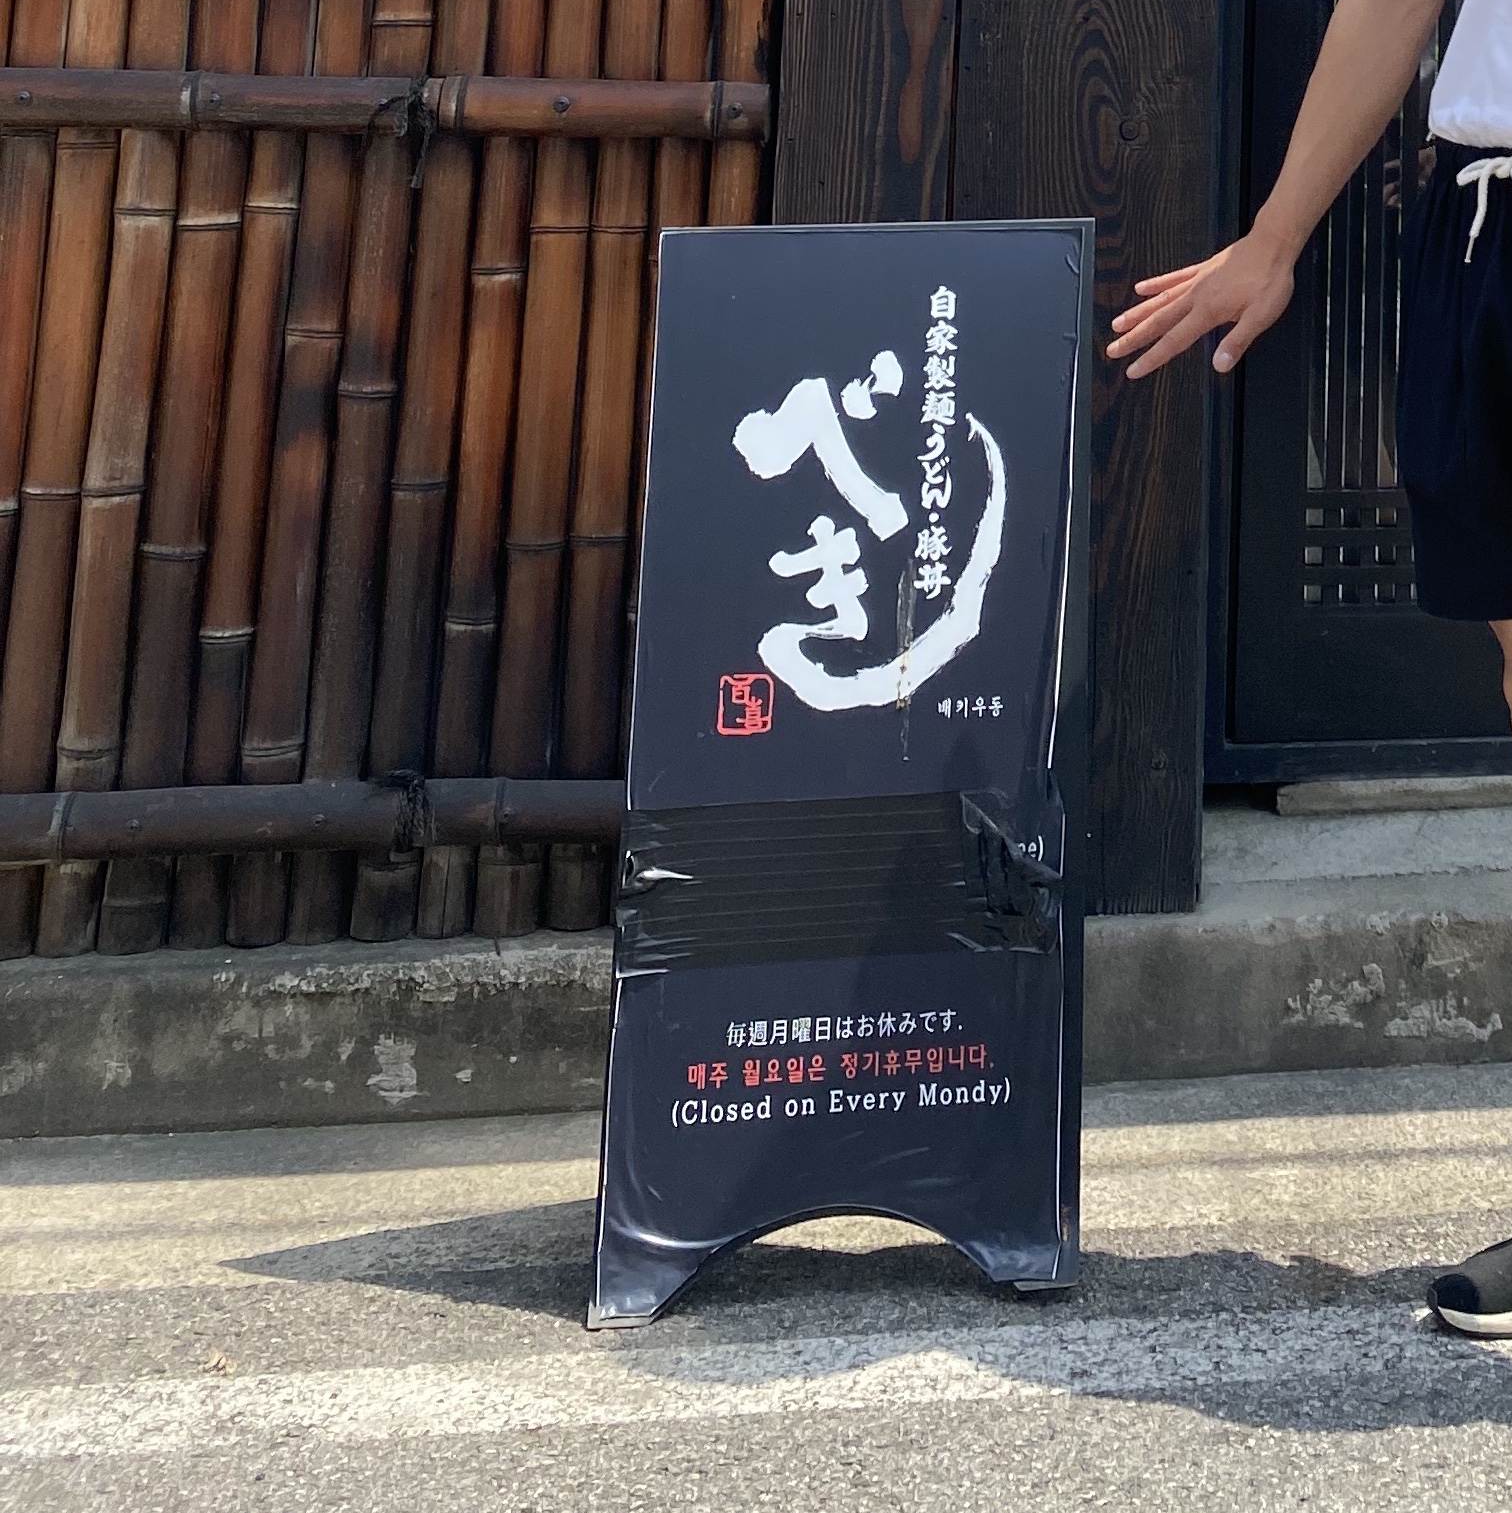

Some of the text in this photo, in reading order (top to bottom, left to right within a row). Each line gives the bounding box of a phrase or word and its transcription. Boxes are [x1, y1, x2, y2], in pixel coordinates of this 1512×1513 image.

[687, 1043, 995, 1090] 매주 월요일은 정기휴무입니다.
[671, 1076, 1012, 1128] (Closed on Every Mondy)
